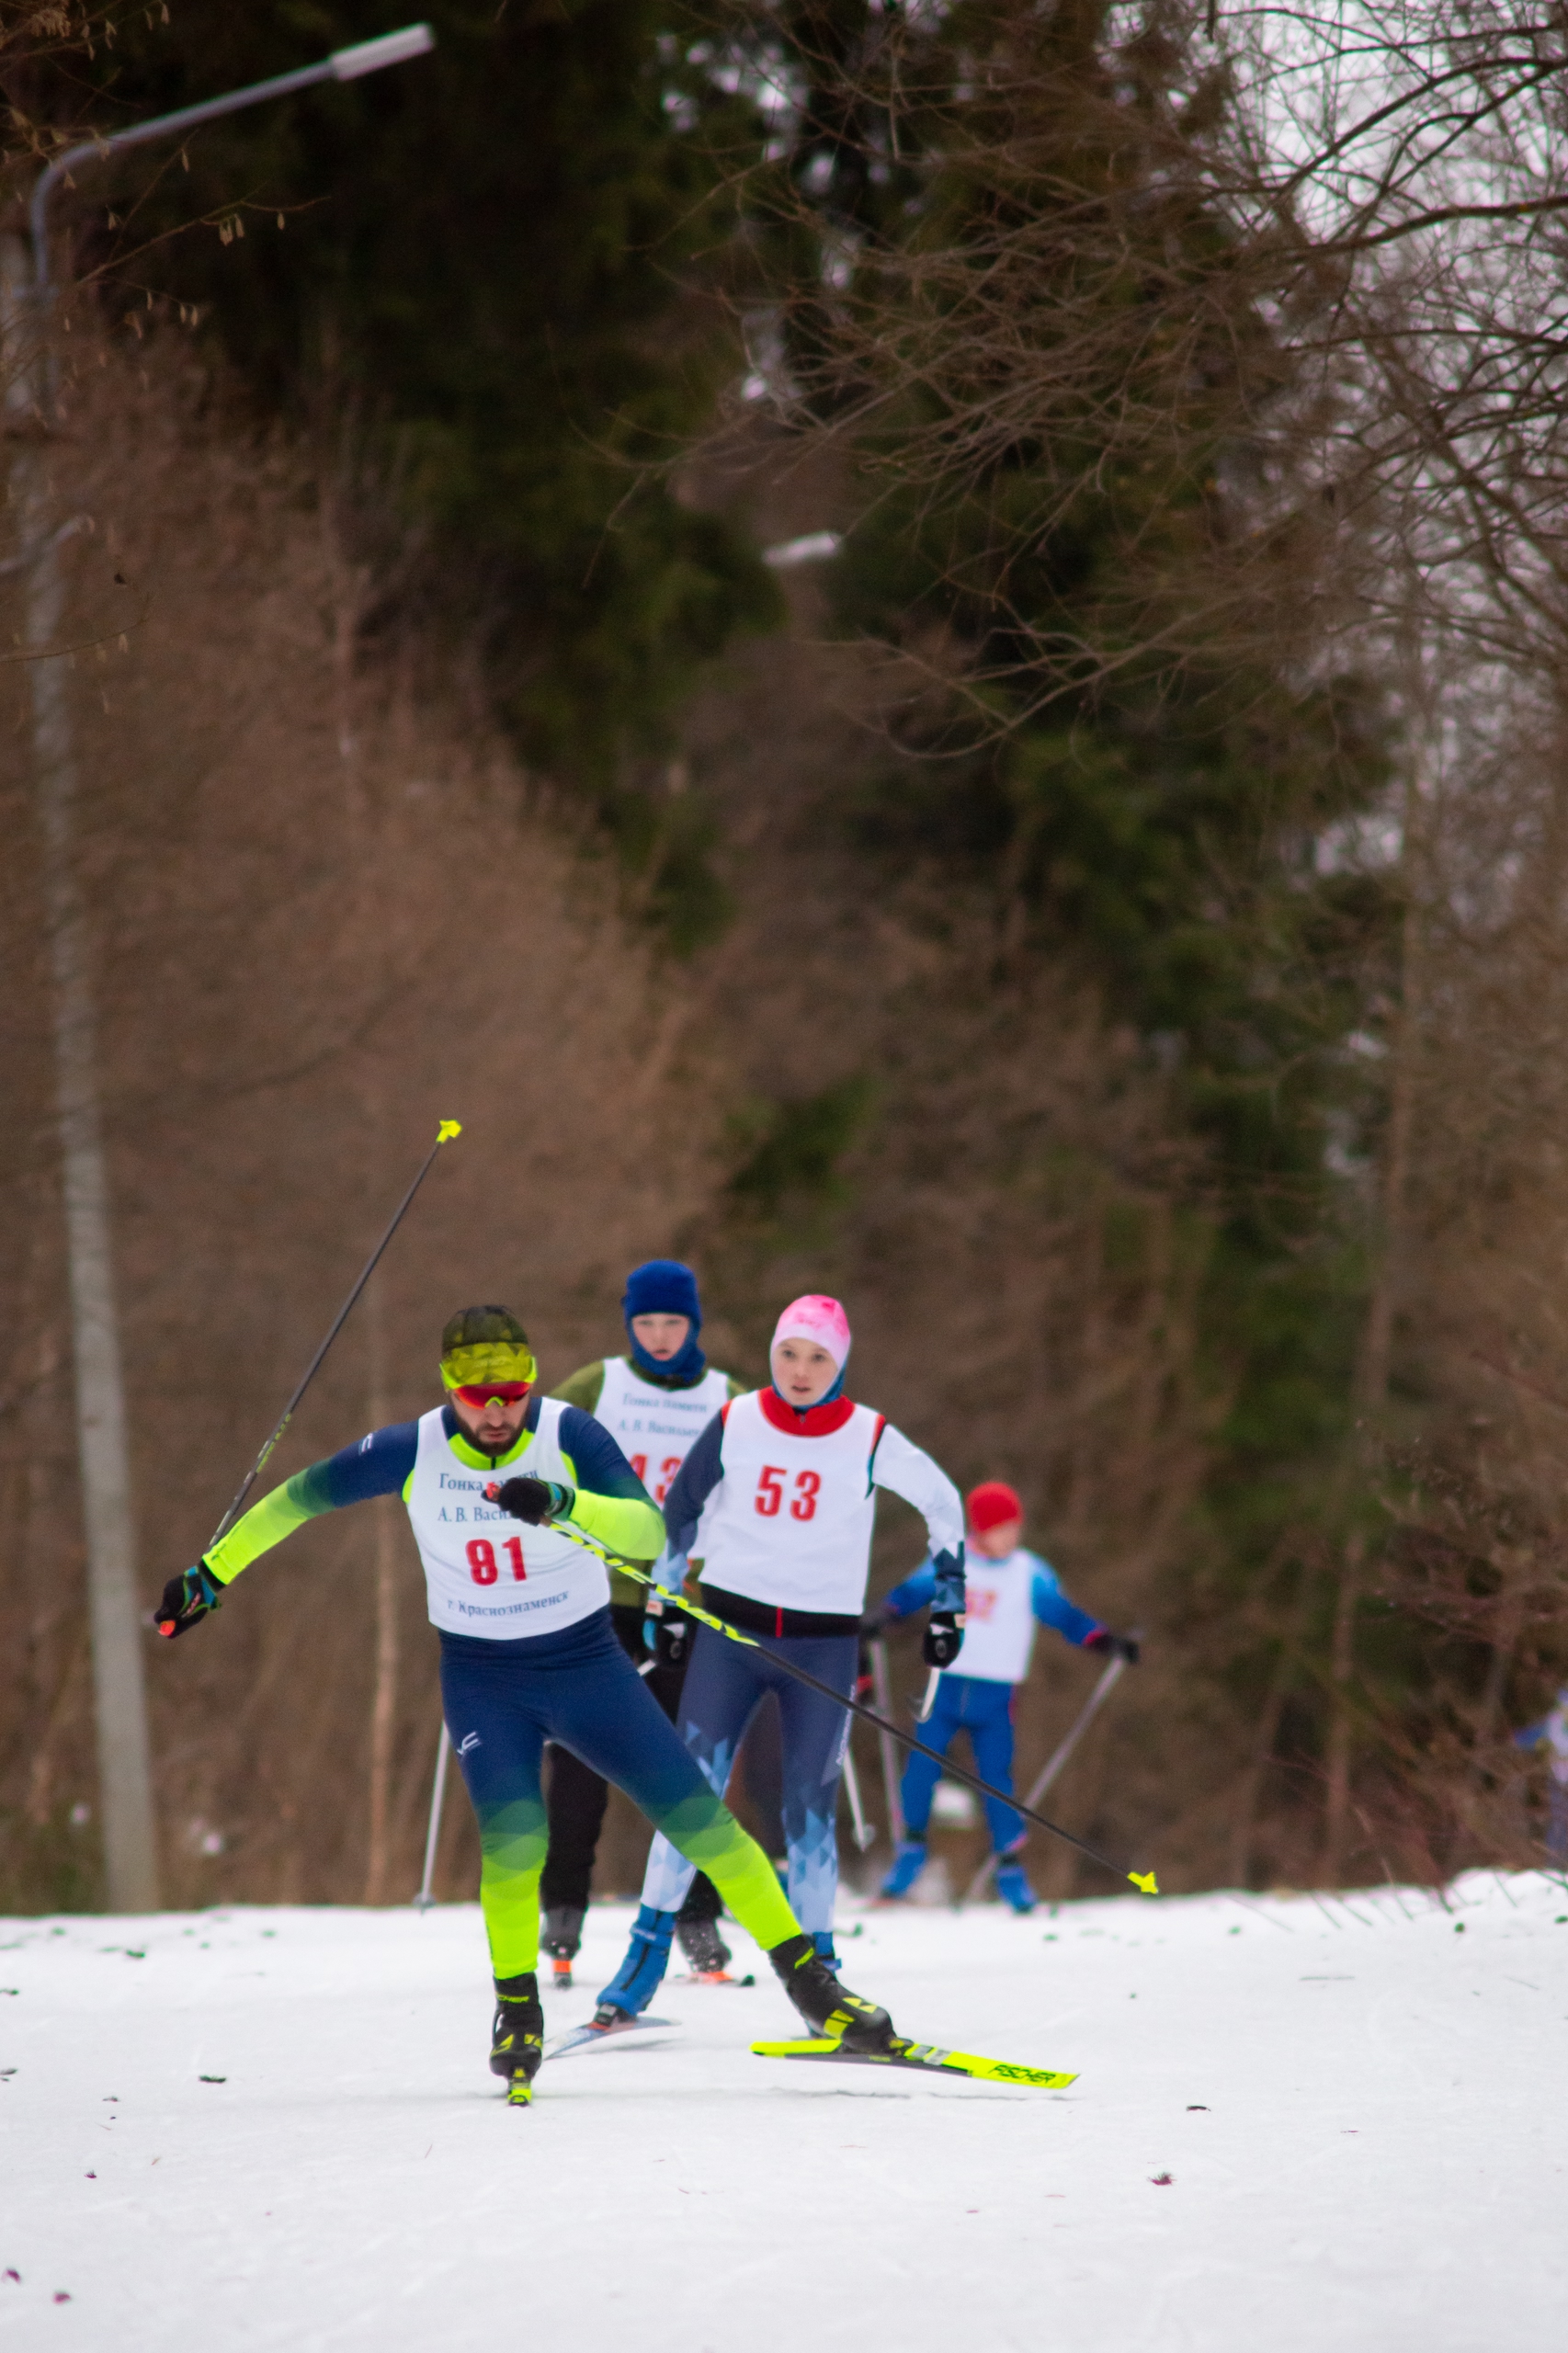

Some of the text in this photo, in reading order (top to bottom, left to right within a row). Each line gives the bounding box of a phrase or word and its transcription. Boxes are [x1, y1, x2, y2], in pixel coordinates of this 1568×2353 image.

[438, 1472, 483, 1491] Гонка
[755, 1464, 822, 1522] 53
[465, 1536, 527, 1586] 81
[459, 1591, 569, 1617] Краснознаменск
[987, 2063, 1056, 2084] FISCHER
